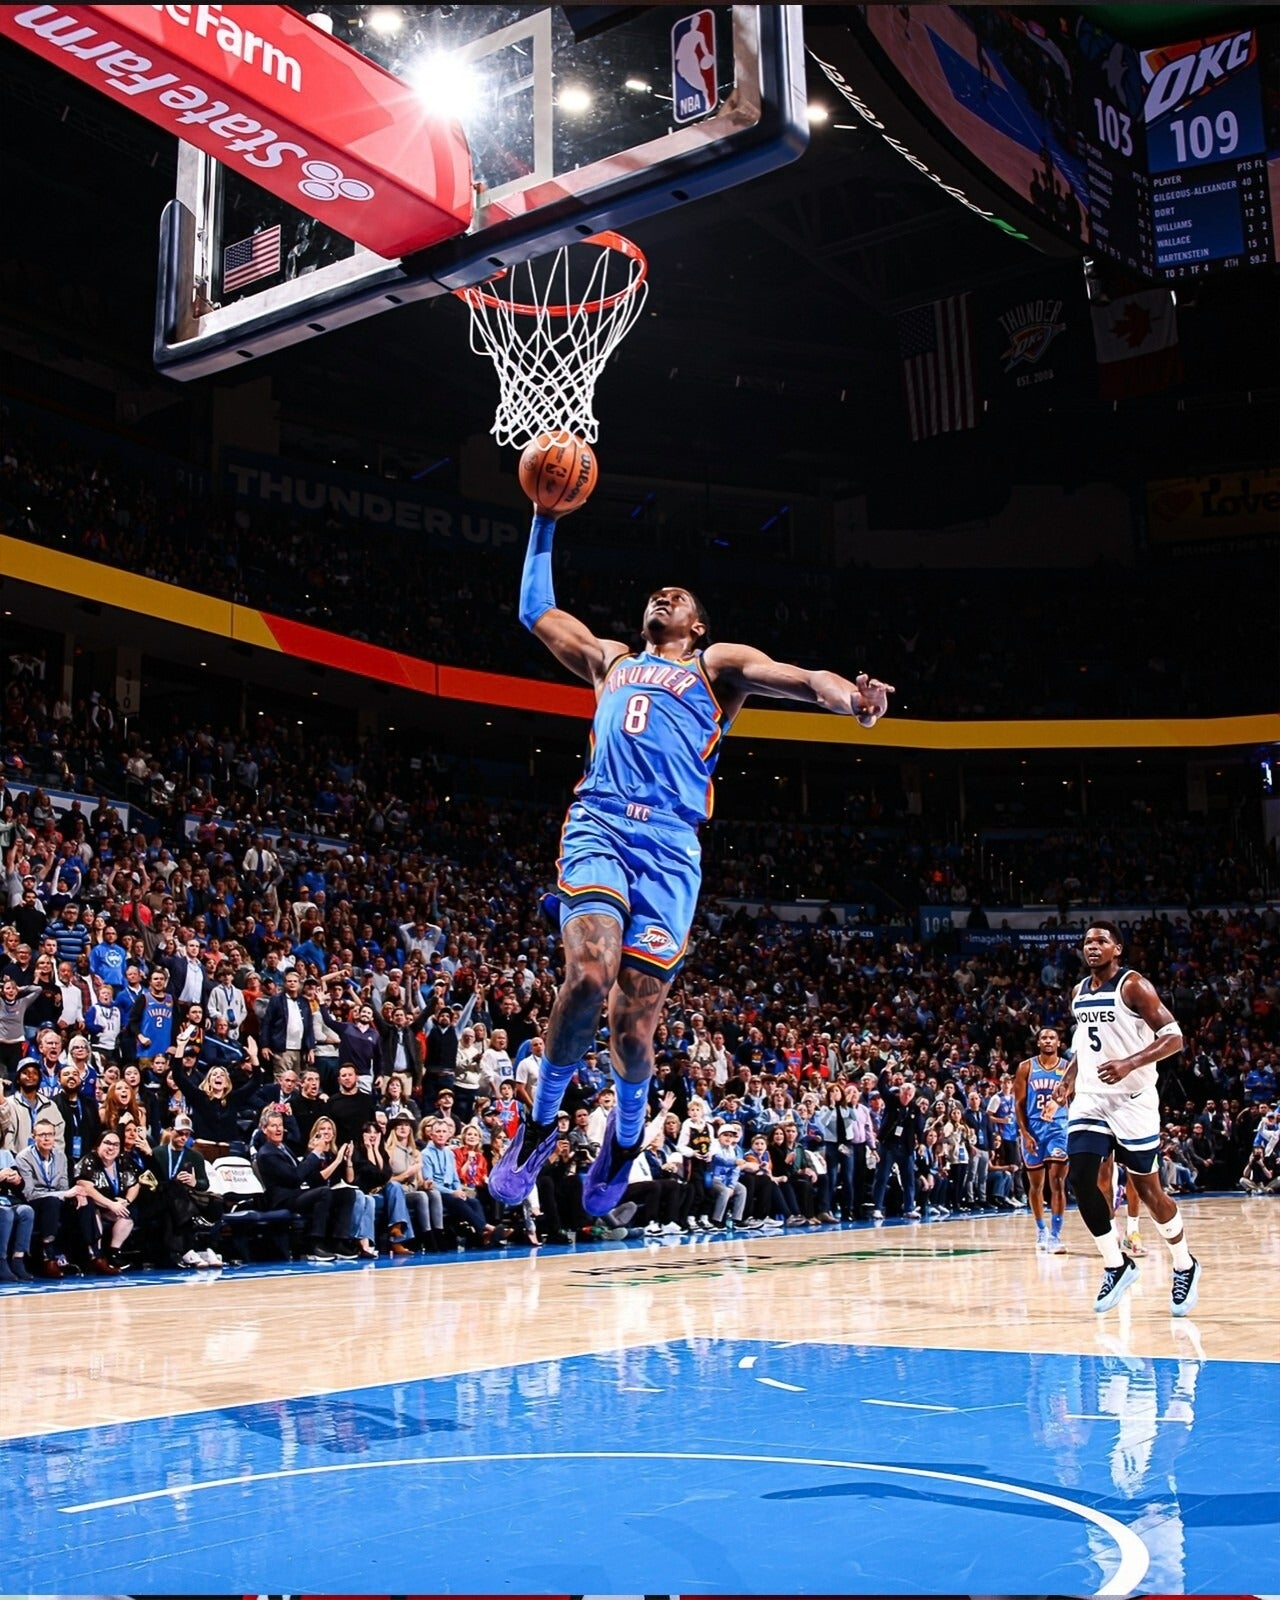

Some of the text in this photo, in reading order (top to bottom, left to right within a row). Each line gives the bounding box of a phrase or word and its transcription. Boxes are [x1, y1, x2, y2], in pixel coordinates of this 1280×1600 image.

[151, 5, 302, 92] eFarm
[14, 6, 309, 170] StateFarm
[1144, 30, 1252, 124] OKC
[680, 94, 701, 115] NBA
[1094, 97, 1133, 157] 103
[1170, 110, 1239, 163] 109
[1153, 160, 1264, 187] PLAYER PTS FL
[1153, 175, 1263, 202] GILGEOUS-ALEXANDER 40 1
[1154, 190, 1265, 218] DORT 14 2
[1155, 206, 1266, 233] WILLIAMS 12 3
[1157, 221, 1267, 248] WALLACE 3 2
[1158, 237, 1268, 264] HARTENSTEIN 15 1
[1165, 254, 1267, 278] TO 2 TF 4 4TH 59.2
[997, 299, 1064, 335] THUNDER
[564, 453, 591, 502] Wilson
[228, 463, 519, 547] THUNDER UP
[608, 666, 698, 698] THUNDER
[623, 693, 651, 734] 8
[625, 803, 650, 821] OKC
[156, 1016, 163, 1028] 2
[1088, 1027, 1102, 1052] 5
[1030, 1078, 1061, 1091] THUND
